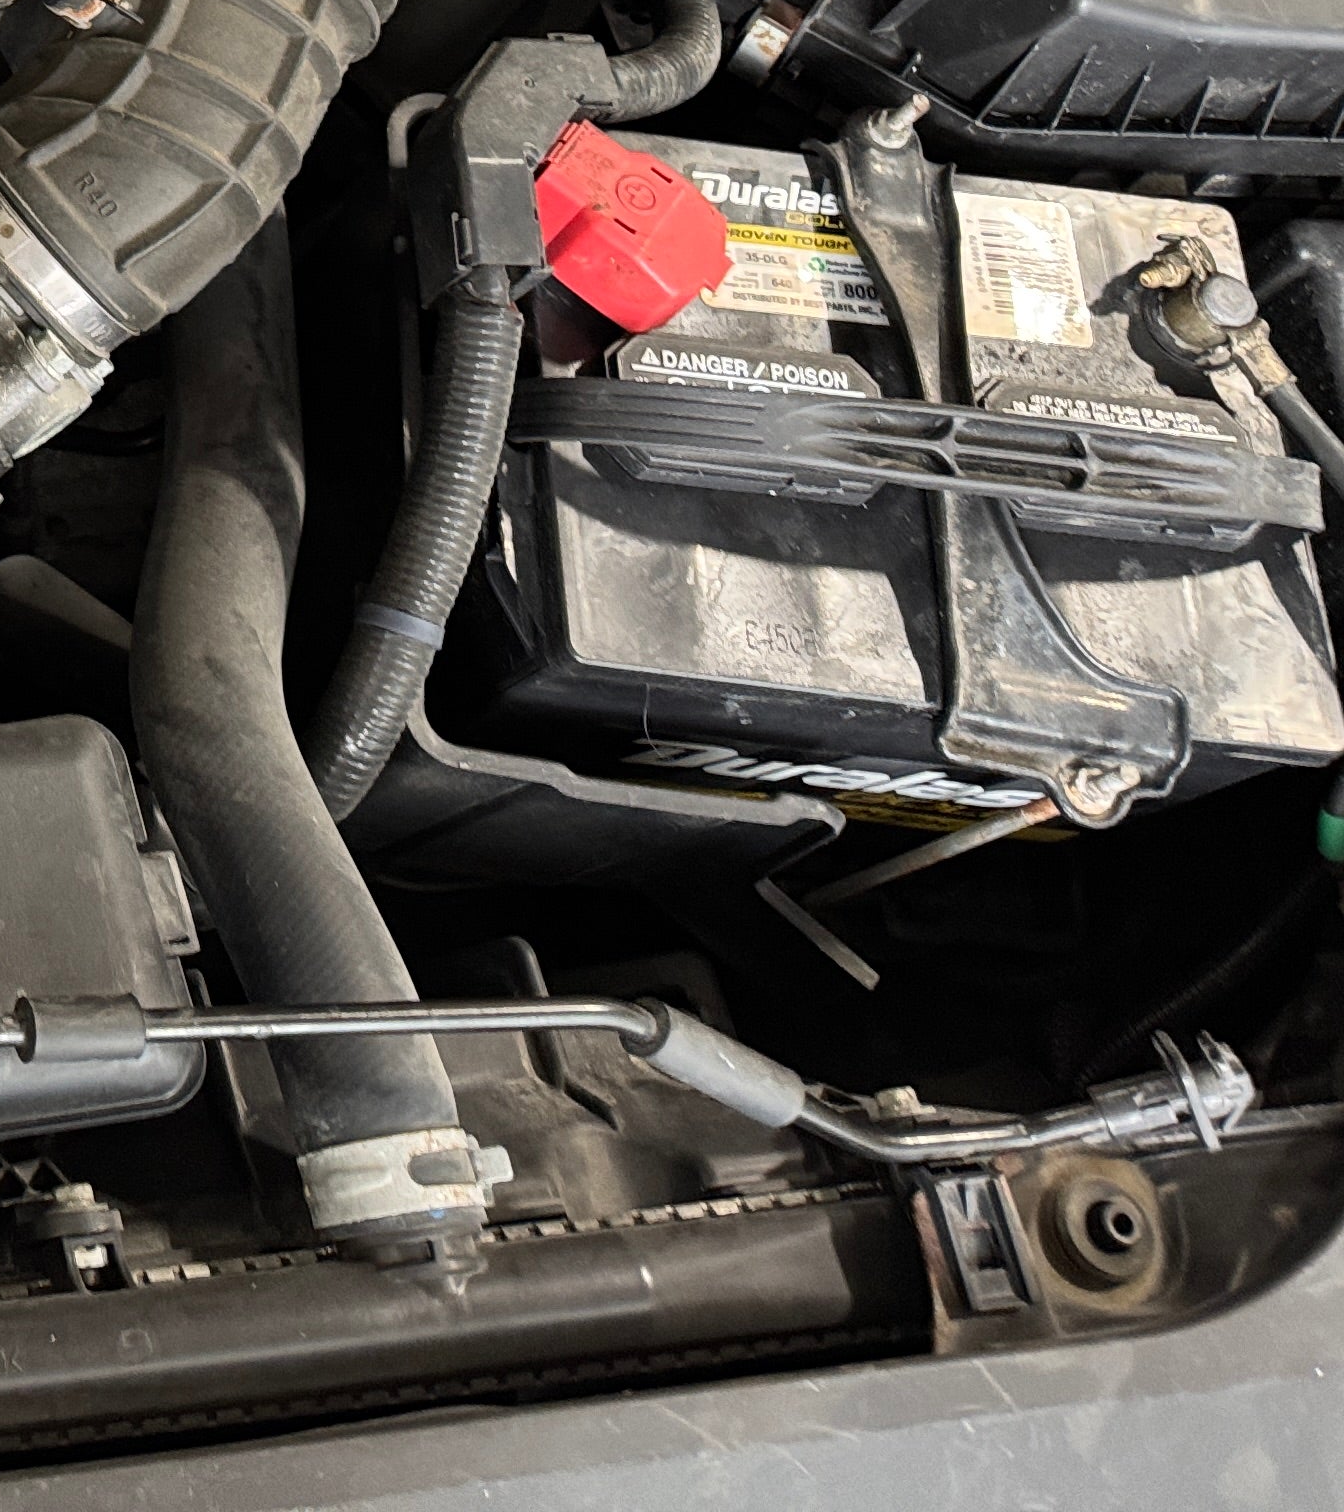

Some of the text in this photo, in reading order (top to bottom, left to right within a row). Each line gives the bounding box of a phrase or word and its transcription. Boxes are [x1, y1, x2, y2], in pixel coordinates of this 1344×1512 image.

[75, 171, 118, 218] R40
[786, 211, 847, 230] GOL
[771, 278, 792, 289] 640
[844, 284, 877, 300] 800
[661, 349, 749, 378] DANGER
[753, 361, 766, 378] /
[770, 362, 849, 390] POISON
